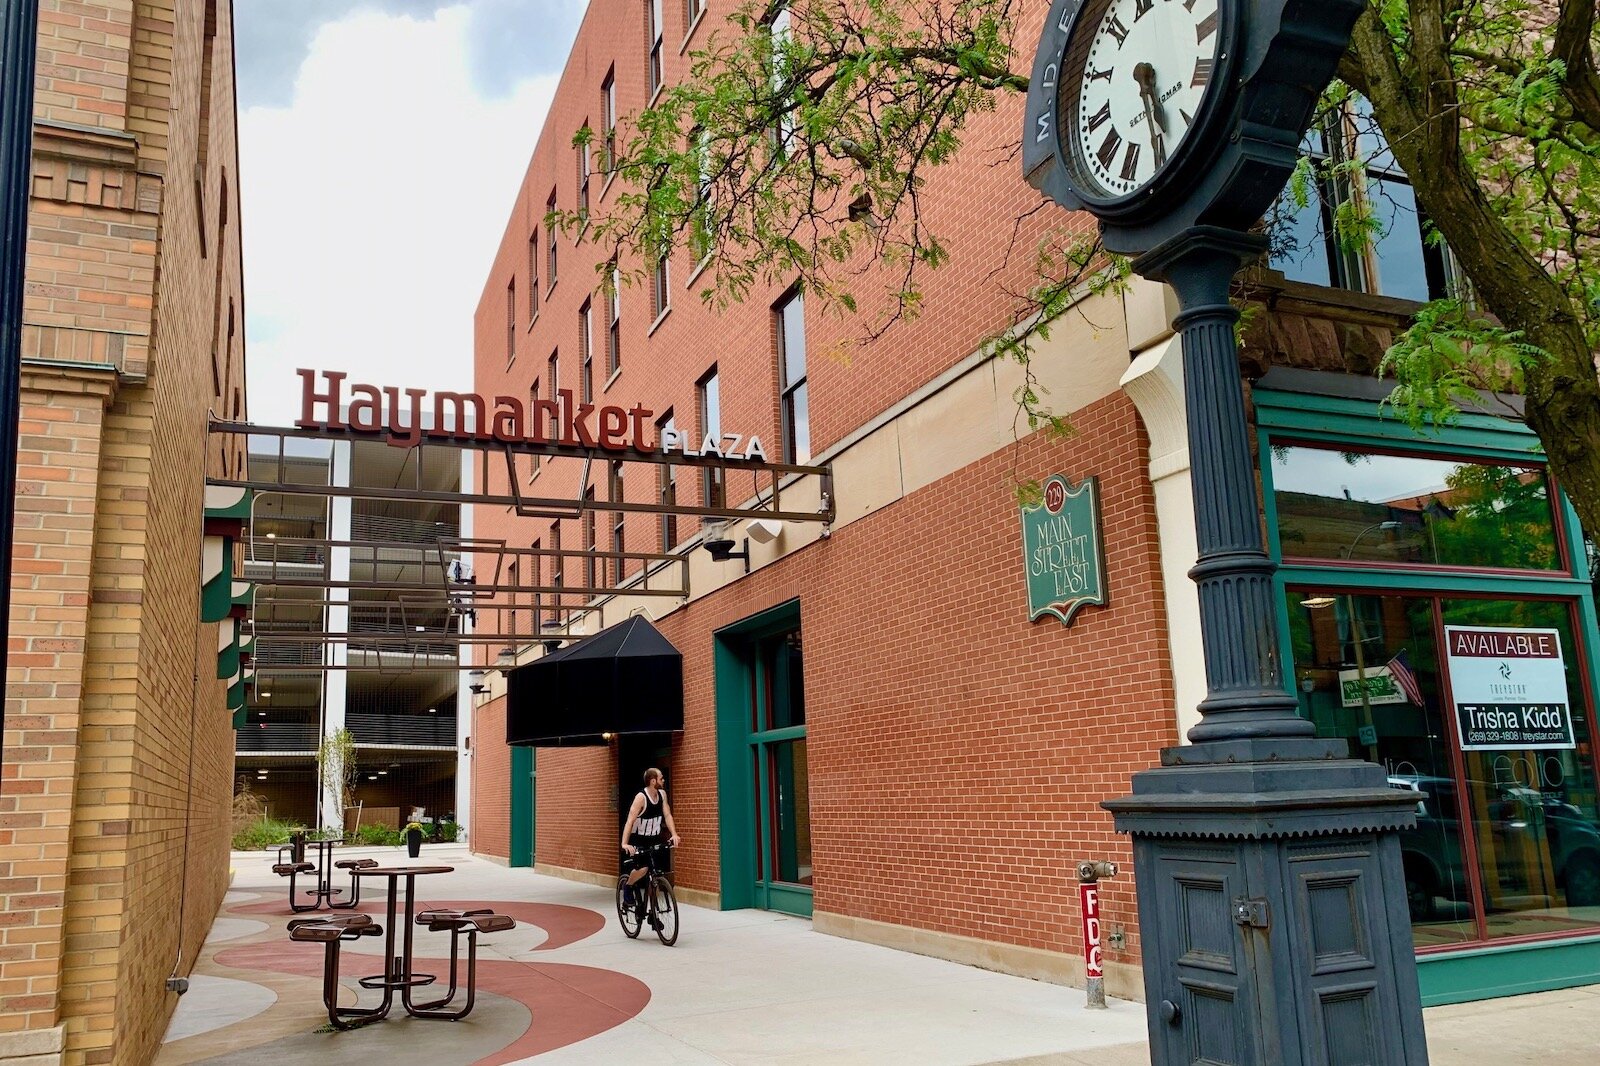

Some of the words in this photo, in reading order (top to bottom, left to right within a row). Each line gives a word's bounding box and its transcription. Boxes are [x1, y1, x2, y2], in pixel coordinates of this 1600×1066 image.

[1158, 80, 1182, 104] OMAS
[295, 368, 655, 449] Haymarket
[660, 428, 768, 462] PLAZA
[1047, 485, 1062, 508] 229
[1036, 512, 1073, 547] MAIN
[1031, 534, 1088, 577] STREET
[1053, 562, 1090, 597] EAST
[1457, 634, 1551, 656] AVAILABLE
[1464, 706, 1520, 729] Trisha
[1521, 706, 1562, 729] Kidd
